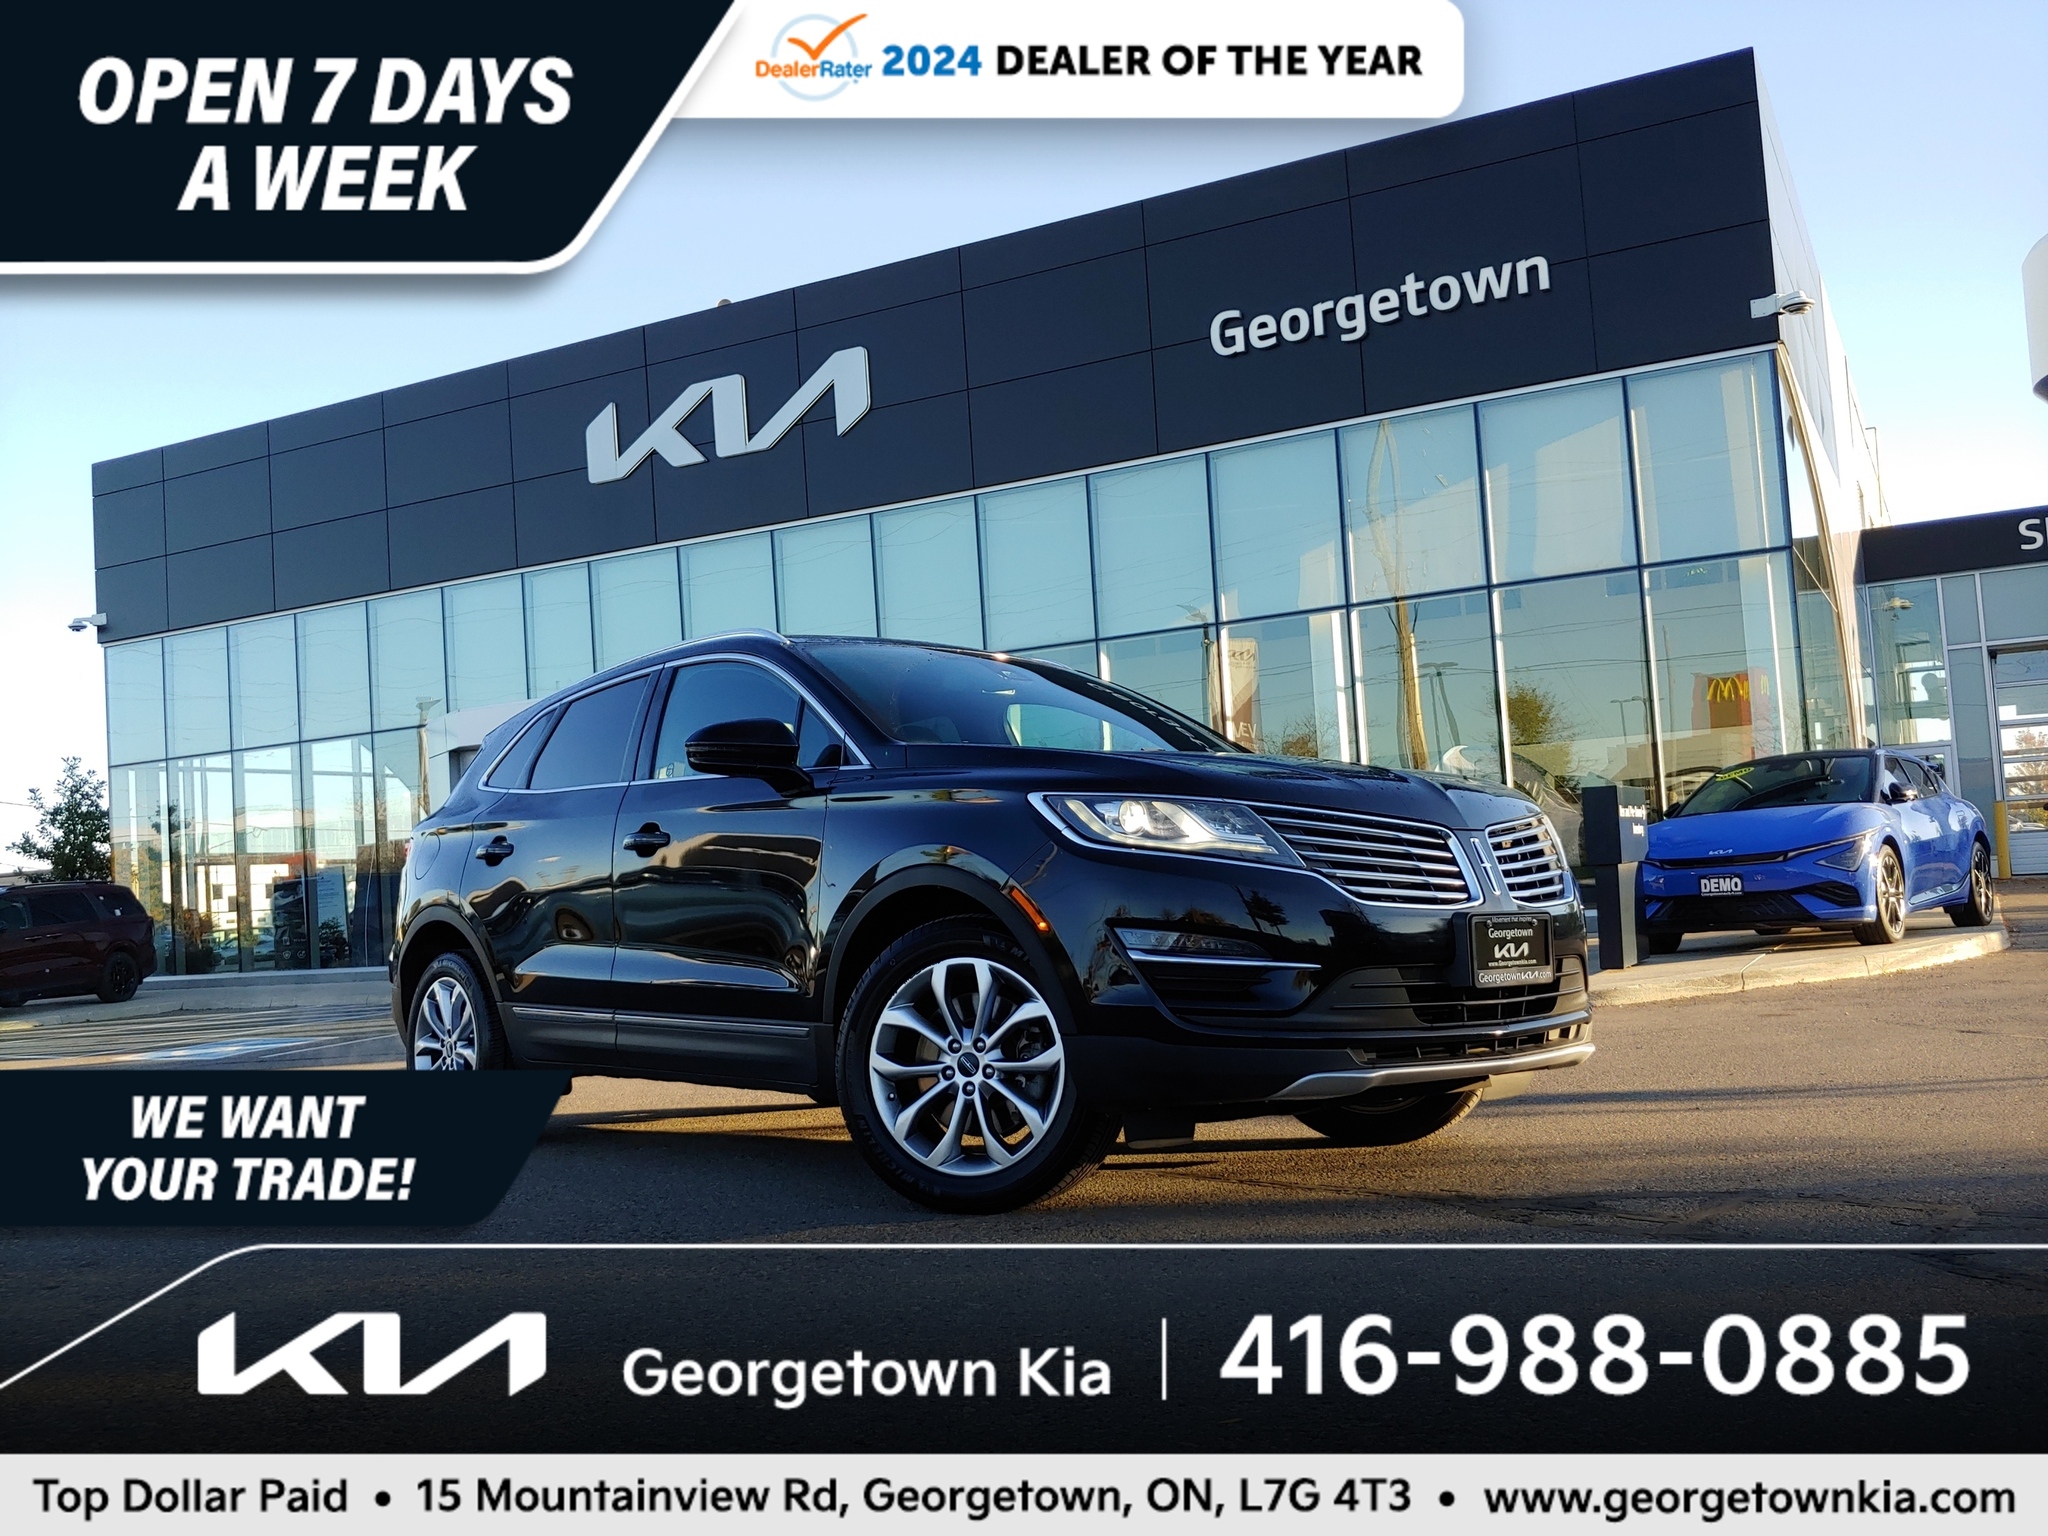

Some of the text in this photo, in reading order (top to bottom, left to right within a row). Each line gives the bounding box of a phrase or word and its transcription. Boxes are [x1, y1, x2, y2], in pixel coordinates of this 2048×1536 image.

[1210, 255, 1550, 356] Georgetown
[586, 346, 870, 484] KIA
[2018, 517, 2048, 550] S
[1700, 877, 1742, 893] DEMO
[1488, 928, 1533, 939] Georgetown
[1494, 942, 1529, 958] KIA
[1478, 971, 1552, 983] GeorgetownKIA.com
